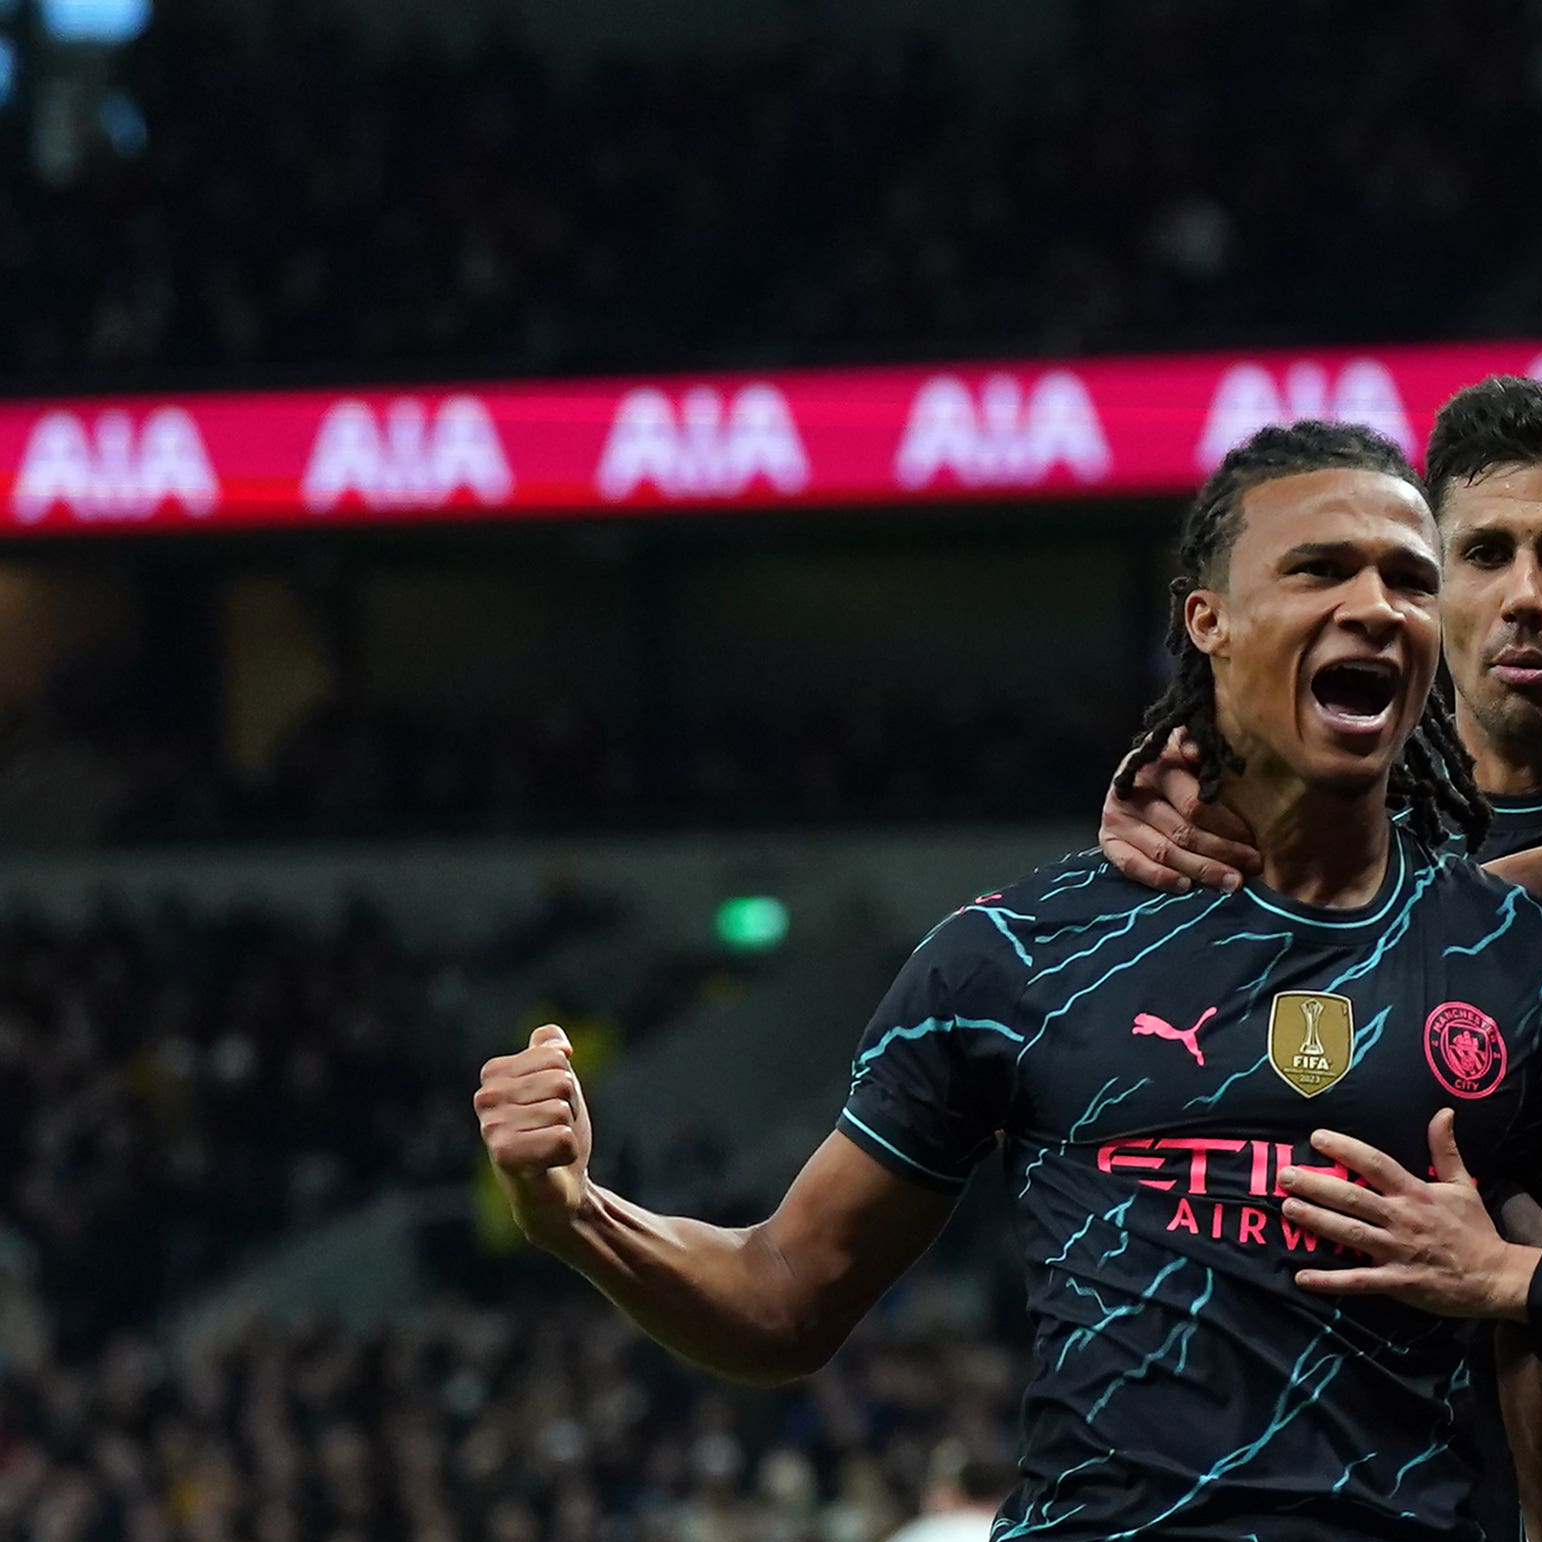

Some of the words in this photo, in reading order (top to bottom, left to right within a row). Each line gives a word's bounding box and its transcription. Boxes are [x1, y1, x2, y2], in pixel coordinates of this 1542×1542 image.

[13, 407, 221, 524] AIA
[302, 394, 514, 513] AIA
[596, 383, 810, 503] AIA
[893, 372, 1110, 488] AIA
[1293, 1055, 1329, 1070] FIFA
[1454, 1079, 1480, 1091] CITY
